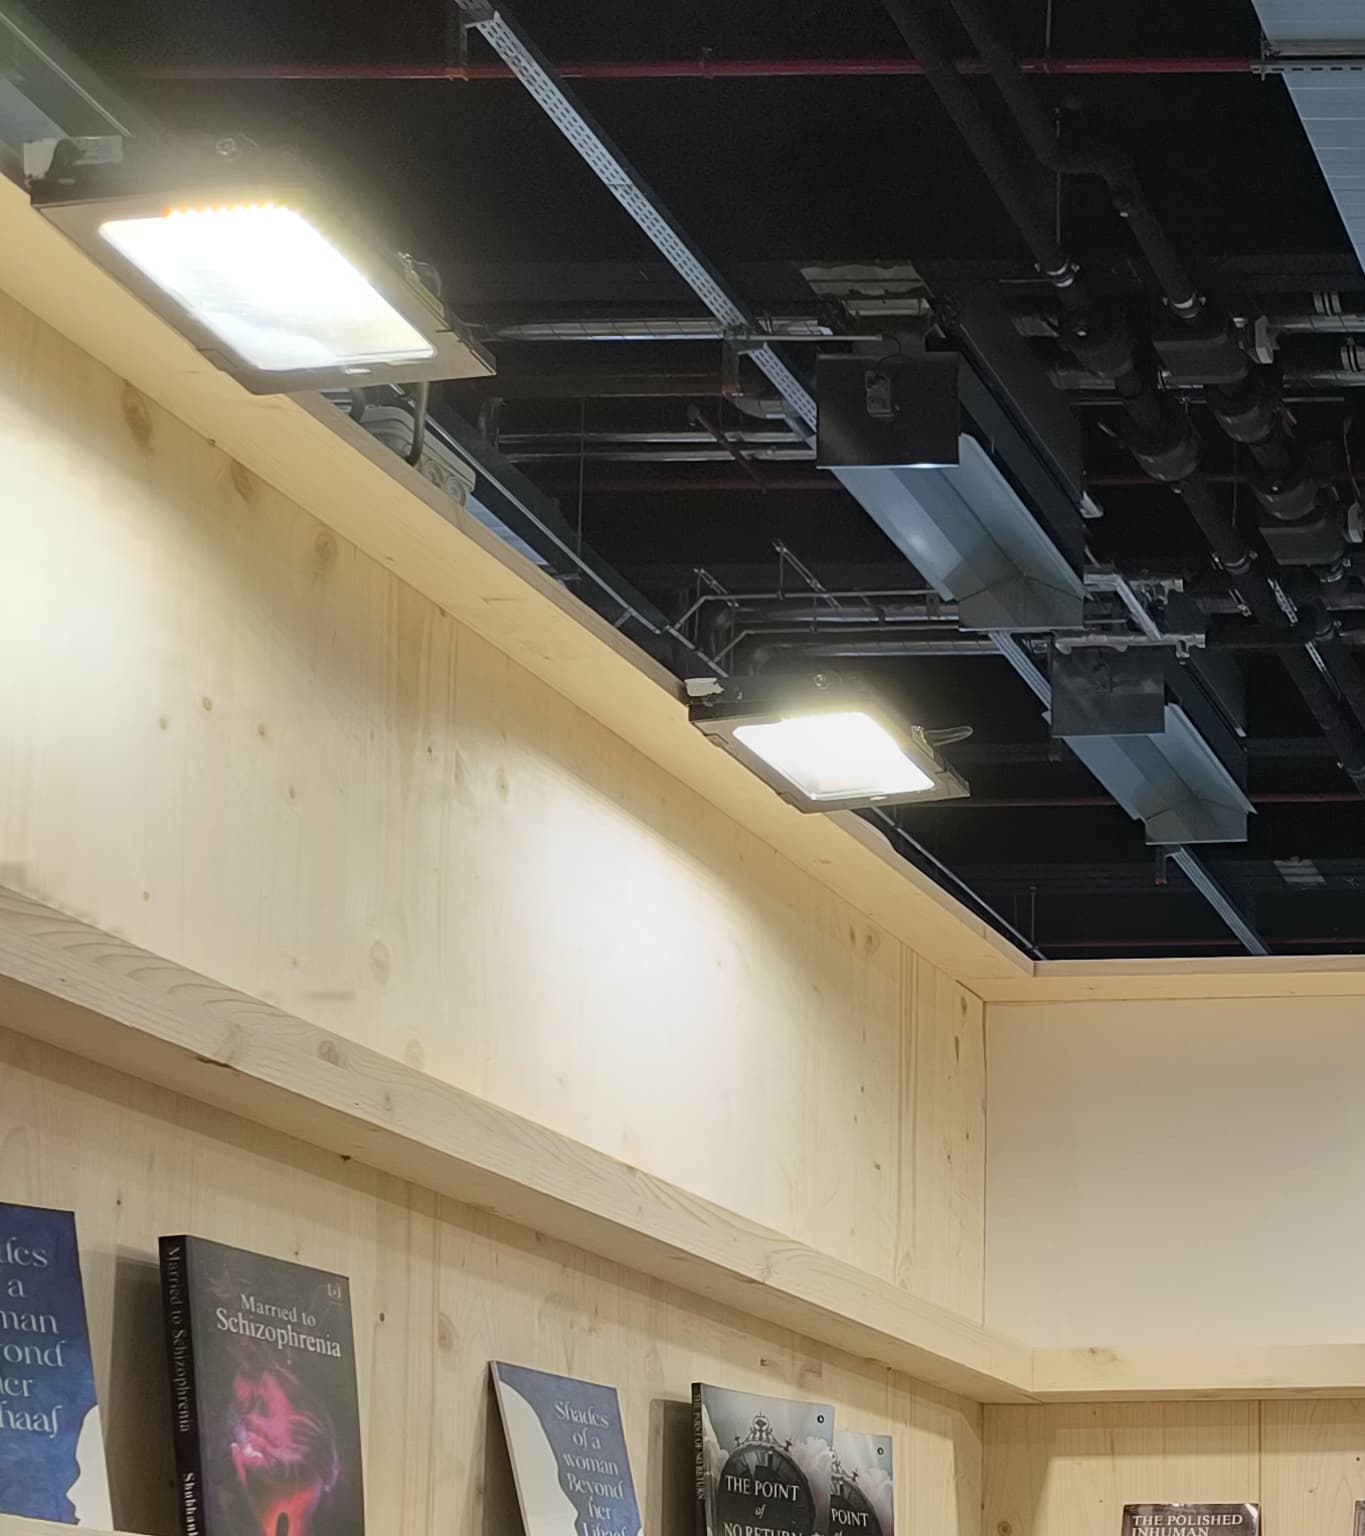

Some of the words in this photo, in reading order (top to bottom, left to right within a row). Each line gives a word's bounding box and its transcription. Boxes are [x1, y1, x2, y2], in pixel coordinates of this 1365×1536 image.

[240, 1294, 298, 1325] Married
[301, 1310, 316, 1328] to
[216, 1308, 342, 1358] Schizophrenia
[555, 1400, 609, 1428] Shades
[562, 1455, 618, 1475] woman
[567, 1473, 625, 1499] Beyond
[725, 1475, 750, 1495] THE
[755, 1481, 799, 1501] POINT
[589, 1497, 612, 1519] her
[832, 1508, 868, 1527] POINT
[1132, 1515, 1163, 1526] THE
[1167, 1514, 1243, 1526] POLISHED
